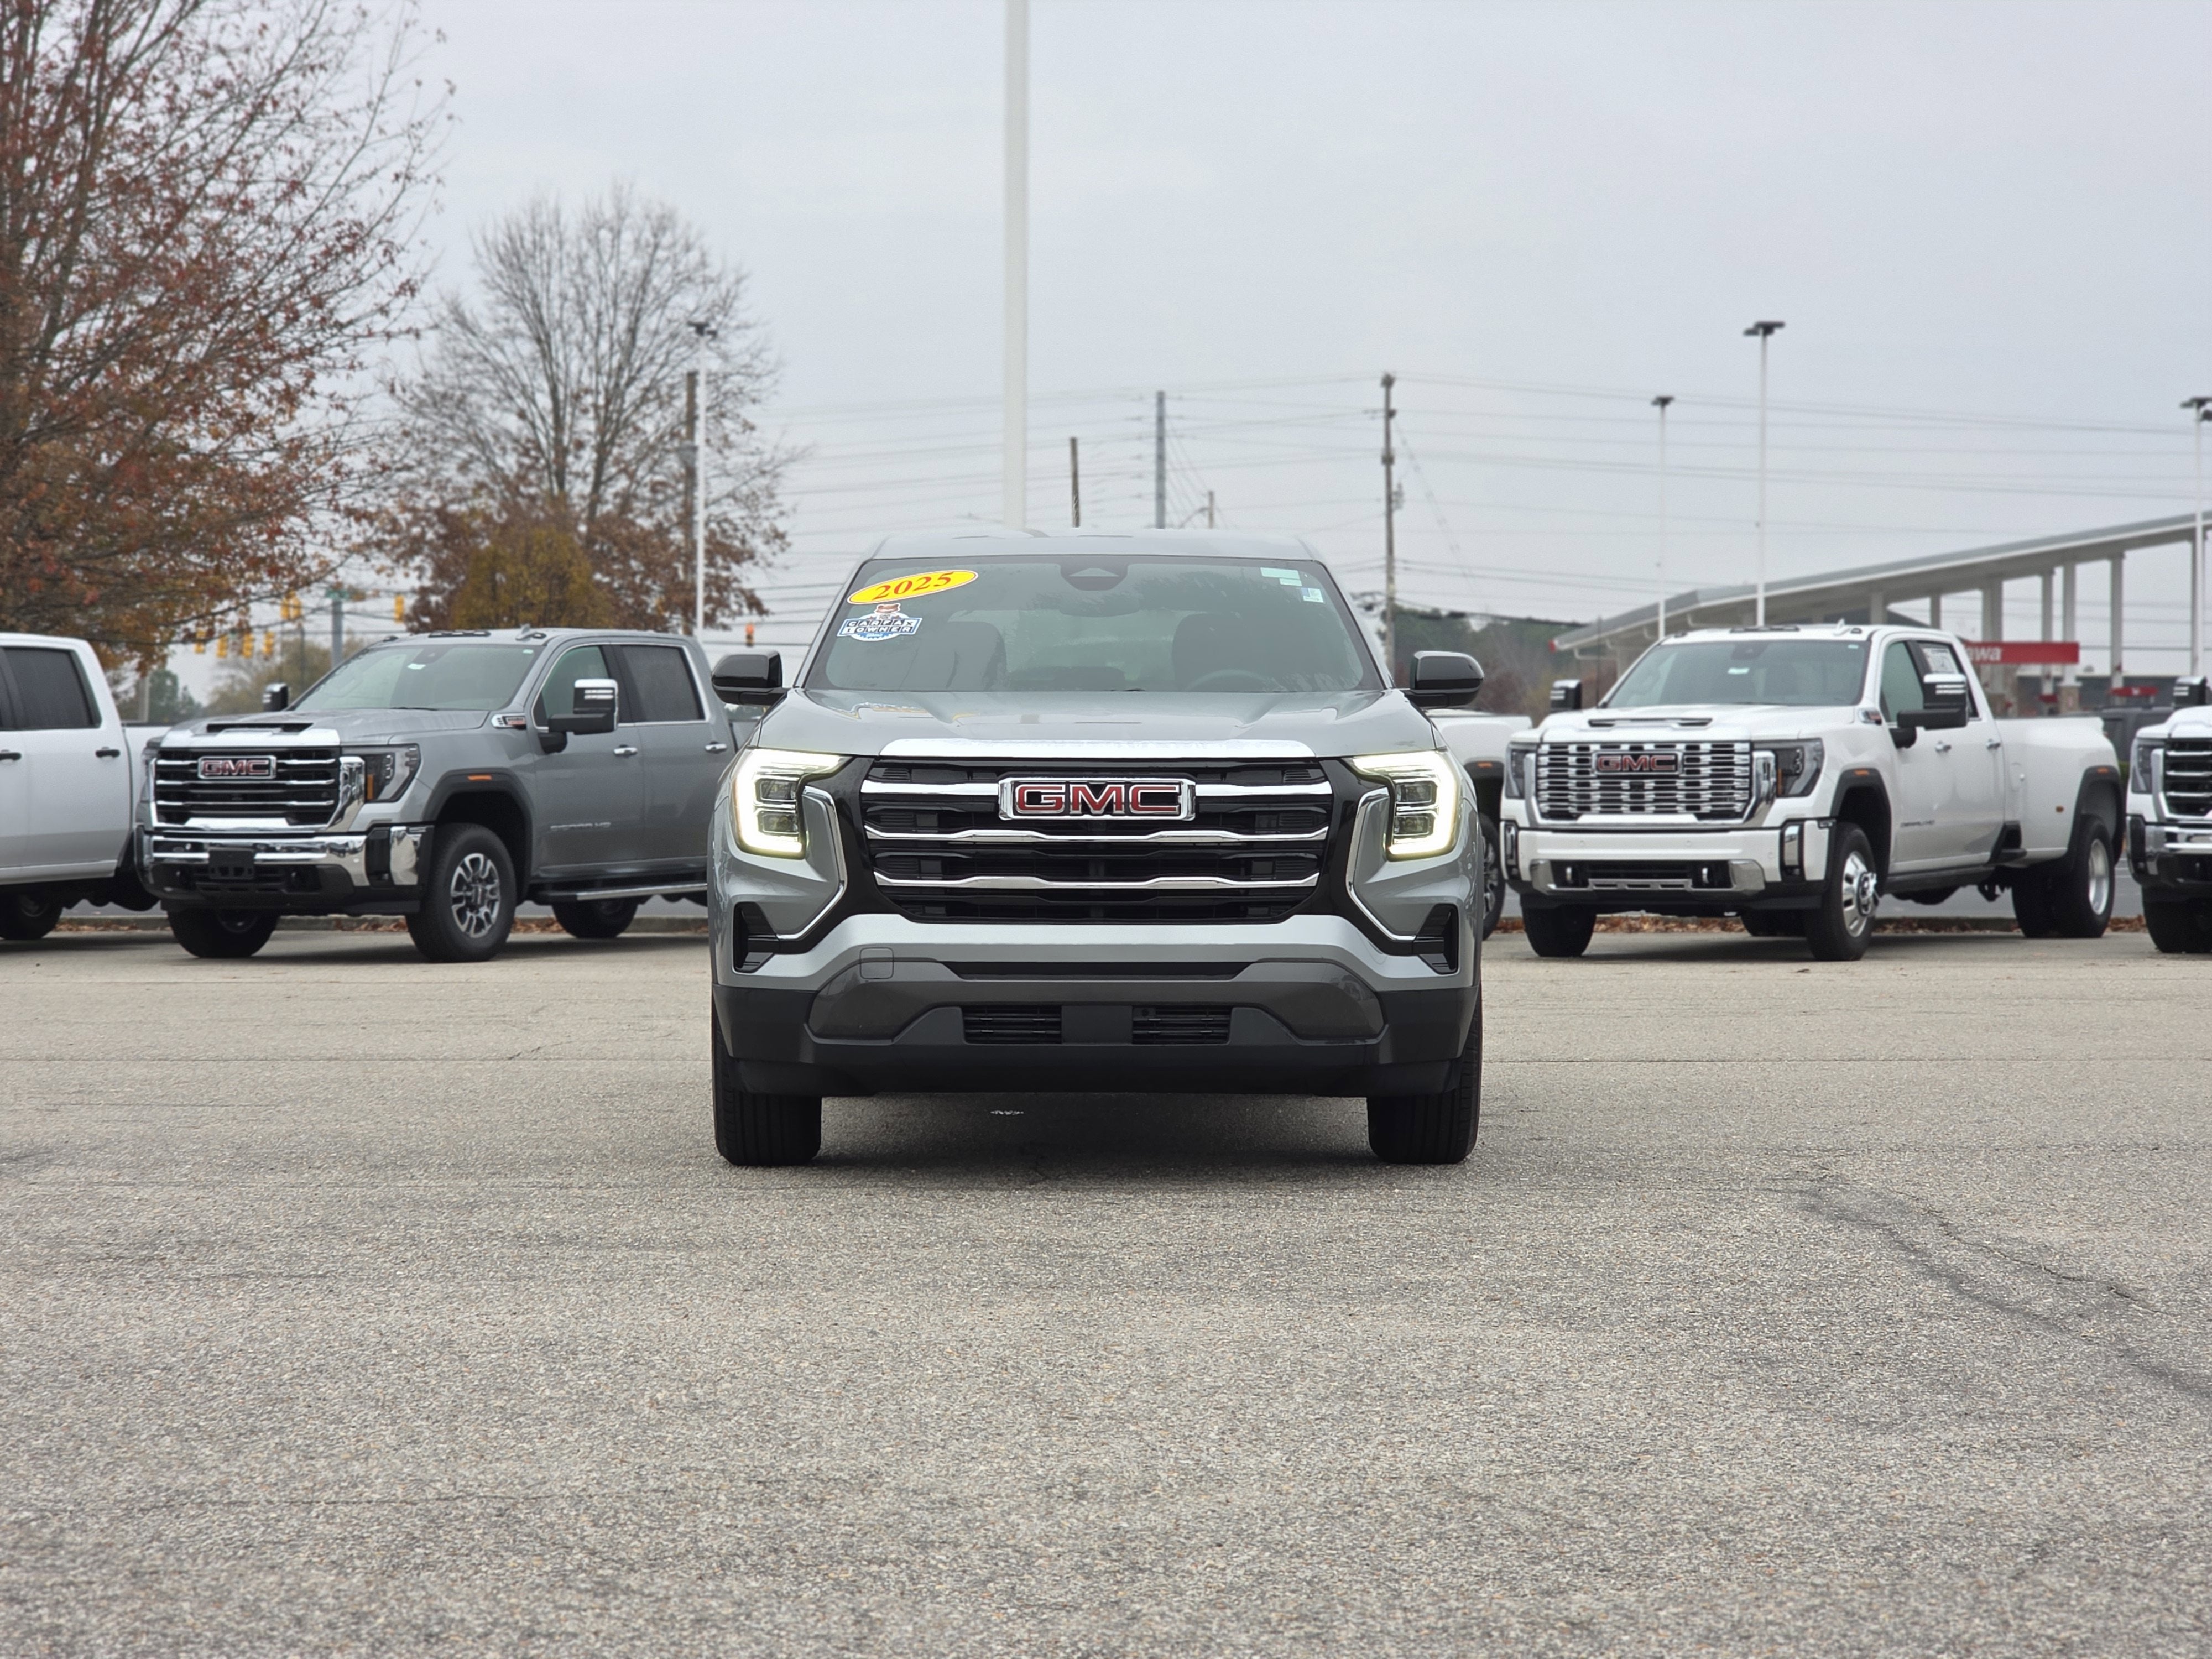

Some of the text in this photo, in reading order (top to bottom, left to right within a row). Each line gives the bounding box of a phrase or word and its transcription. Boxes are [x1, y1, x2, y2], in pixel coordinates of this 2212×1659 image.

[872, 571, 954, 601] 2025
[1966, 646, 2002, 662] awa
[201, 759, 269, 776] GMC
[1597, 755, 1676, 771] GMC
[1015, 784, 1180, 815] GMC
